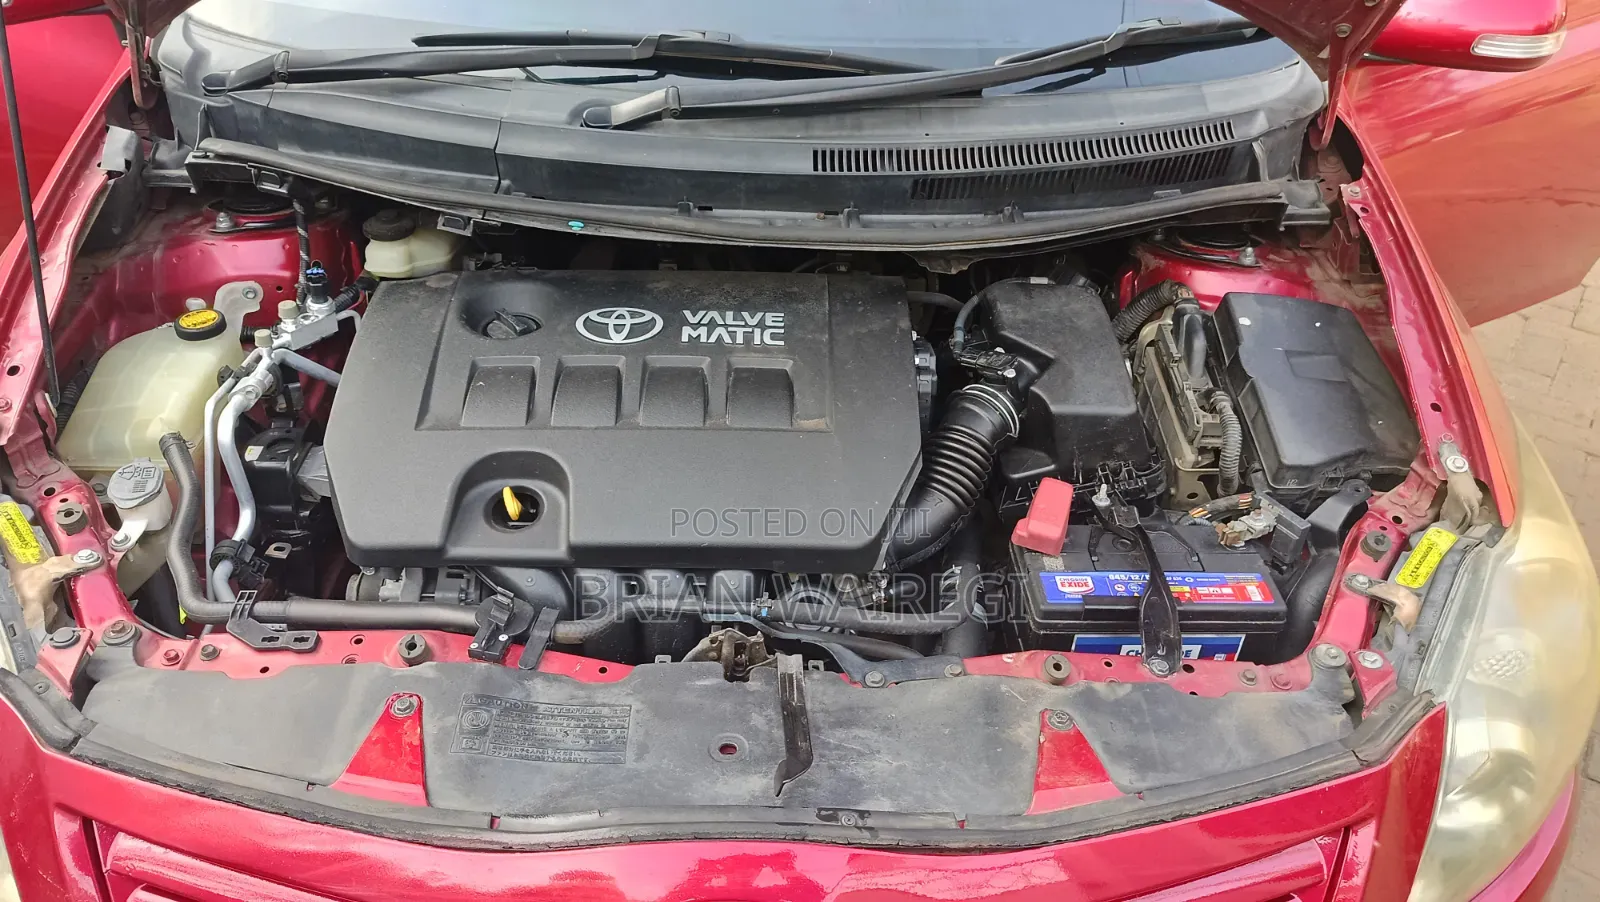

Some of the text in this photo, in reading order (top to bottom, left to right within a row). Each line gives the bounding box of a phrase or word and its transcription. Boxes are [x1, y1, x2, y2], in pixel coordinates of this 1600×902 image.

[682, 310, 785, 327] VALVE
[681, 326, 785, 346] MATIC
[478, 697, 529, 710] CAUTION
